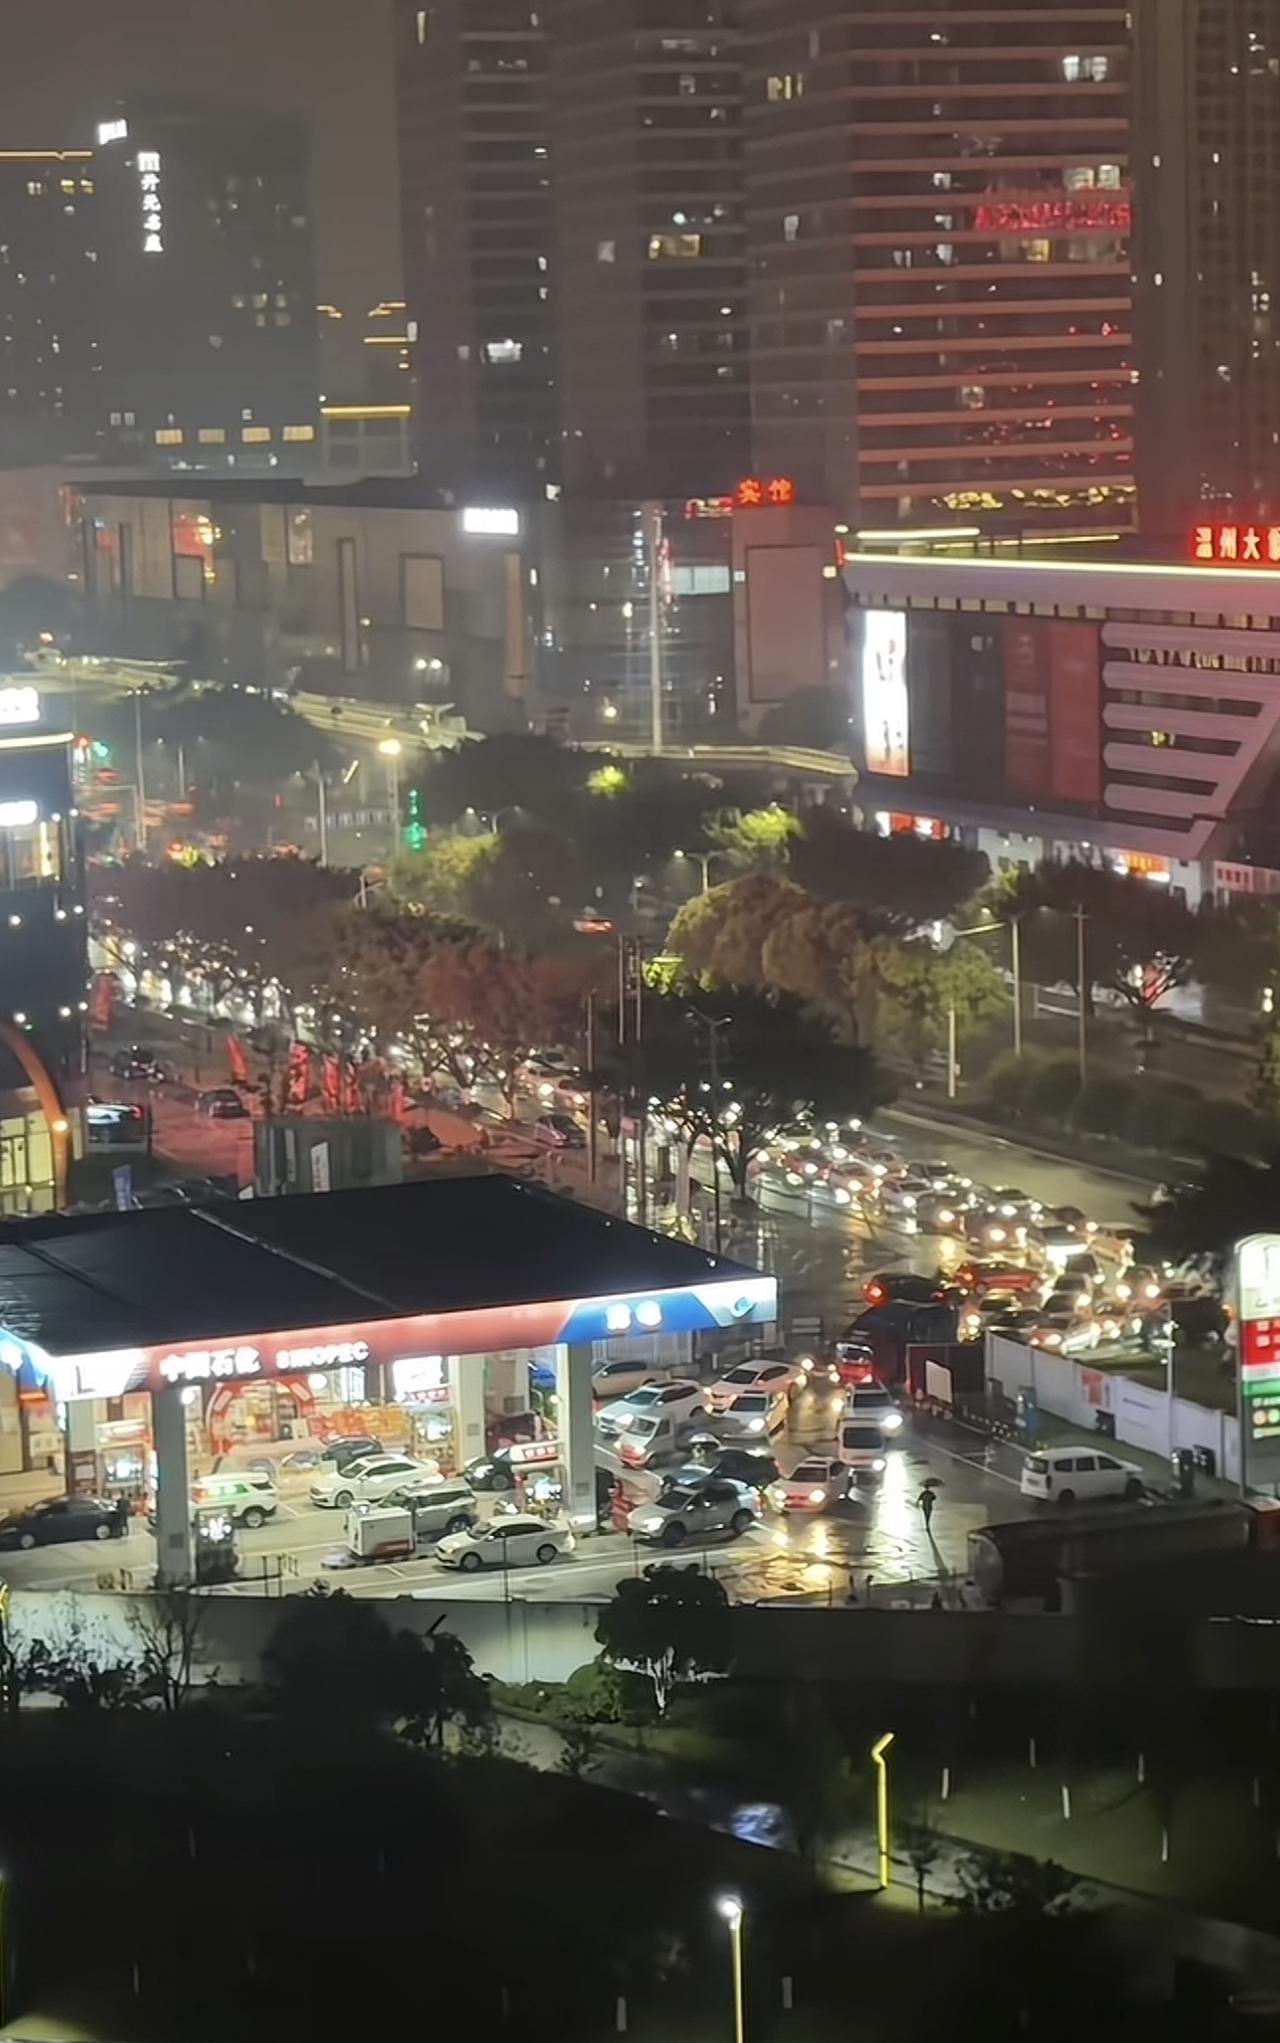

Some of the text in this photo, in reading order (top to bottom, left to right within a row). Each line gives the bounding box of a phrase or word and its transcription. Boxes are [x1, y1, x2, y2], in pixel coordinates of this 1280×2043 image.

[160, 1341, 369, 1382] 中国石化 SINOPEC
